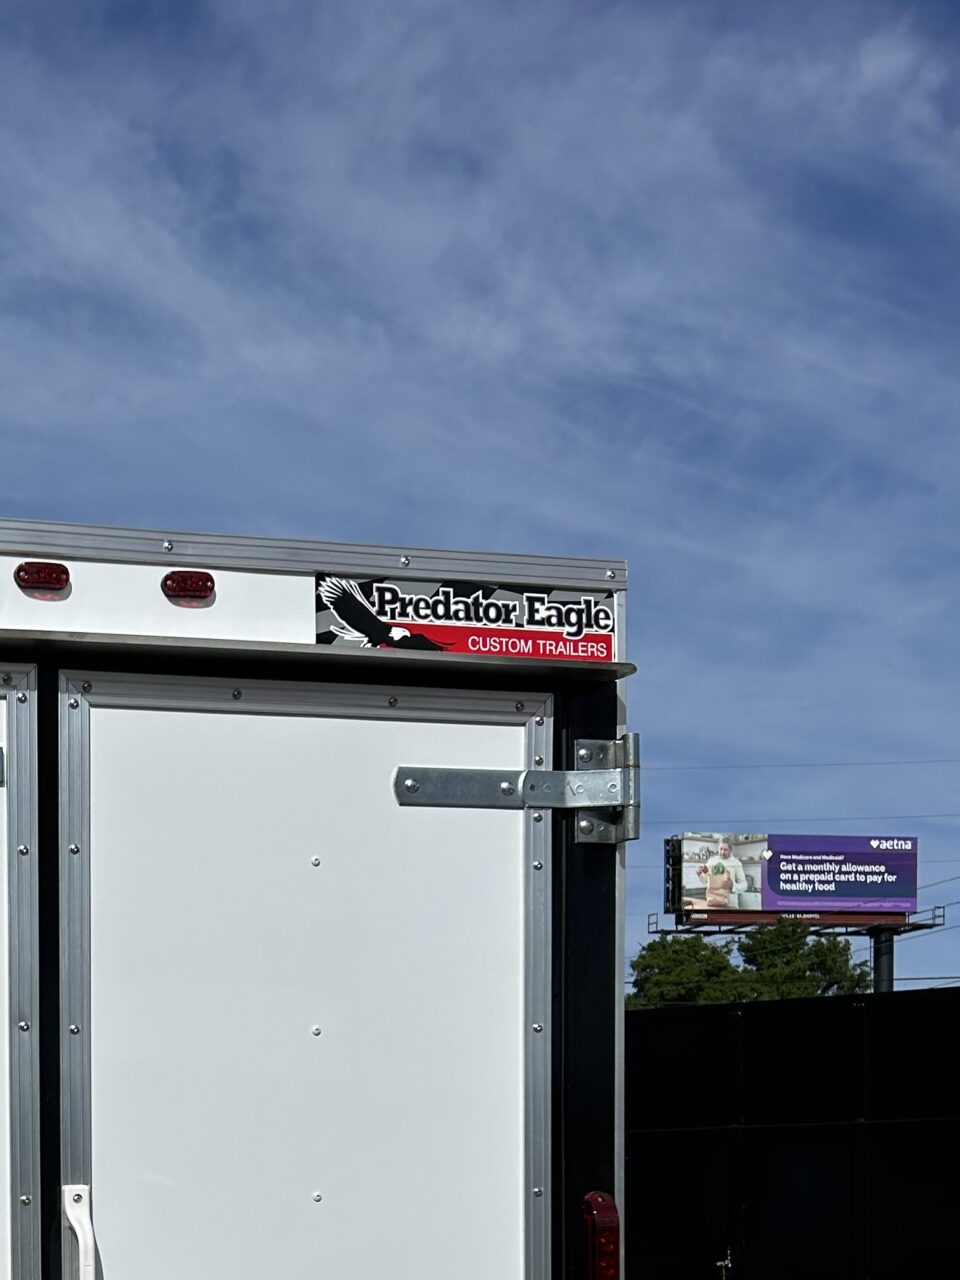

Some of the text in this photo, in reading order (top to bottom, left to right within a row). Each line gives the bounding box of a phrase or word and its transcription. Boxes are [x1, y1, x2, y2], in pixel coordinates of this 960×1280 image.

[373, 583, 613, 639] Predator Eagle
[468, 635, 607, 657] CUSTOM TRAILERS
[880, 838, 912, 850] aetna
[780, 861, 796, 871] Get
[804, 862, 840, 873] monthly
[841, 862, 886, 872] allowance
[800, 872, 833, 882] prepaid
[834, 872, 855, 881] card
[856, 873, 865, 881] to
[866, 874, 883, 884] pay
[884, 873, 897, 882] for
[780, 881, 835, 892] healthy food
